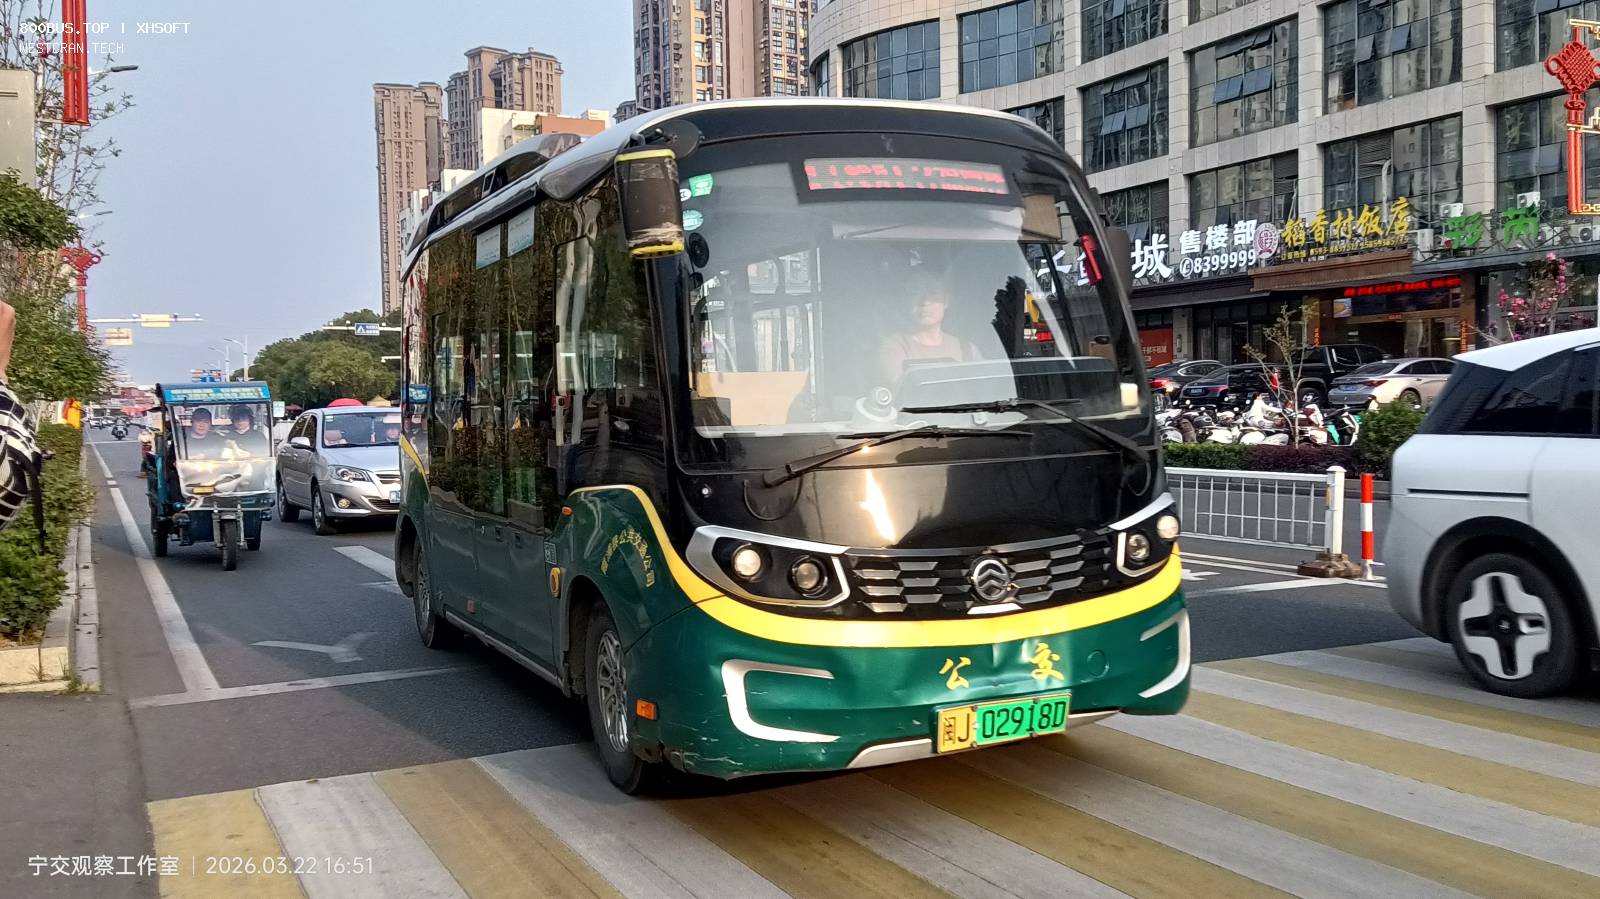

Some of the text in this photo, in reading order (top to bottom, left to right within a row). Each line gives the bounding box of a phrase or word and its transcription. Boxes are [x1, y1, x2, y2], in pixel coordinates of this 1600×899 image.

[1179, 221, 1257, 254] 售楼部
[1281, 196, 1409, 247] 稻香村饭店
[1193, 249, 1257, 274] 8399999
[939, 642, 1065, 690] 公交
